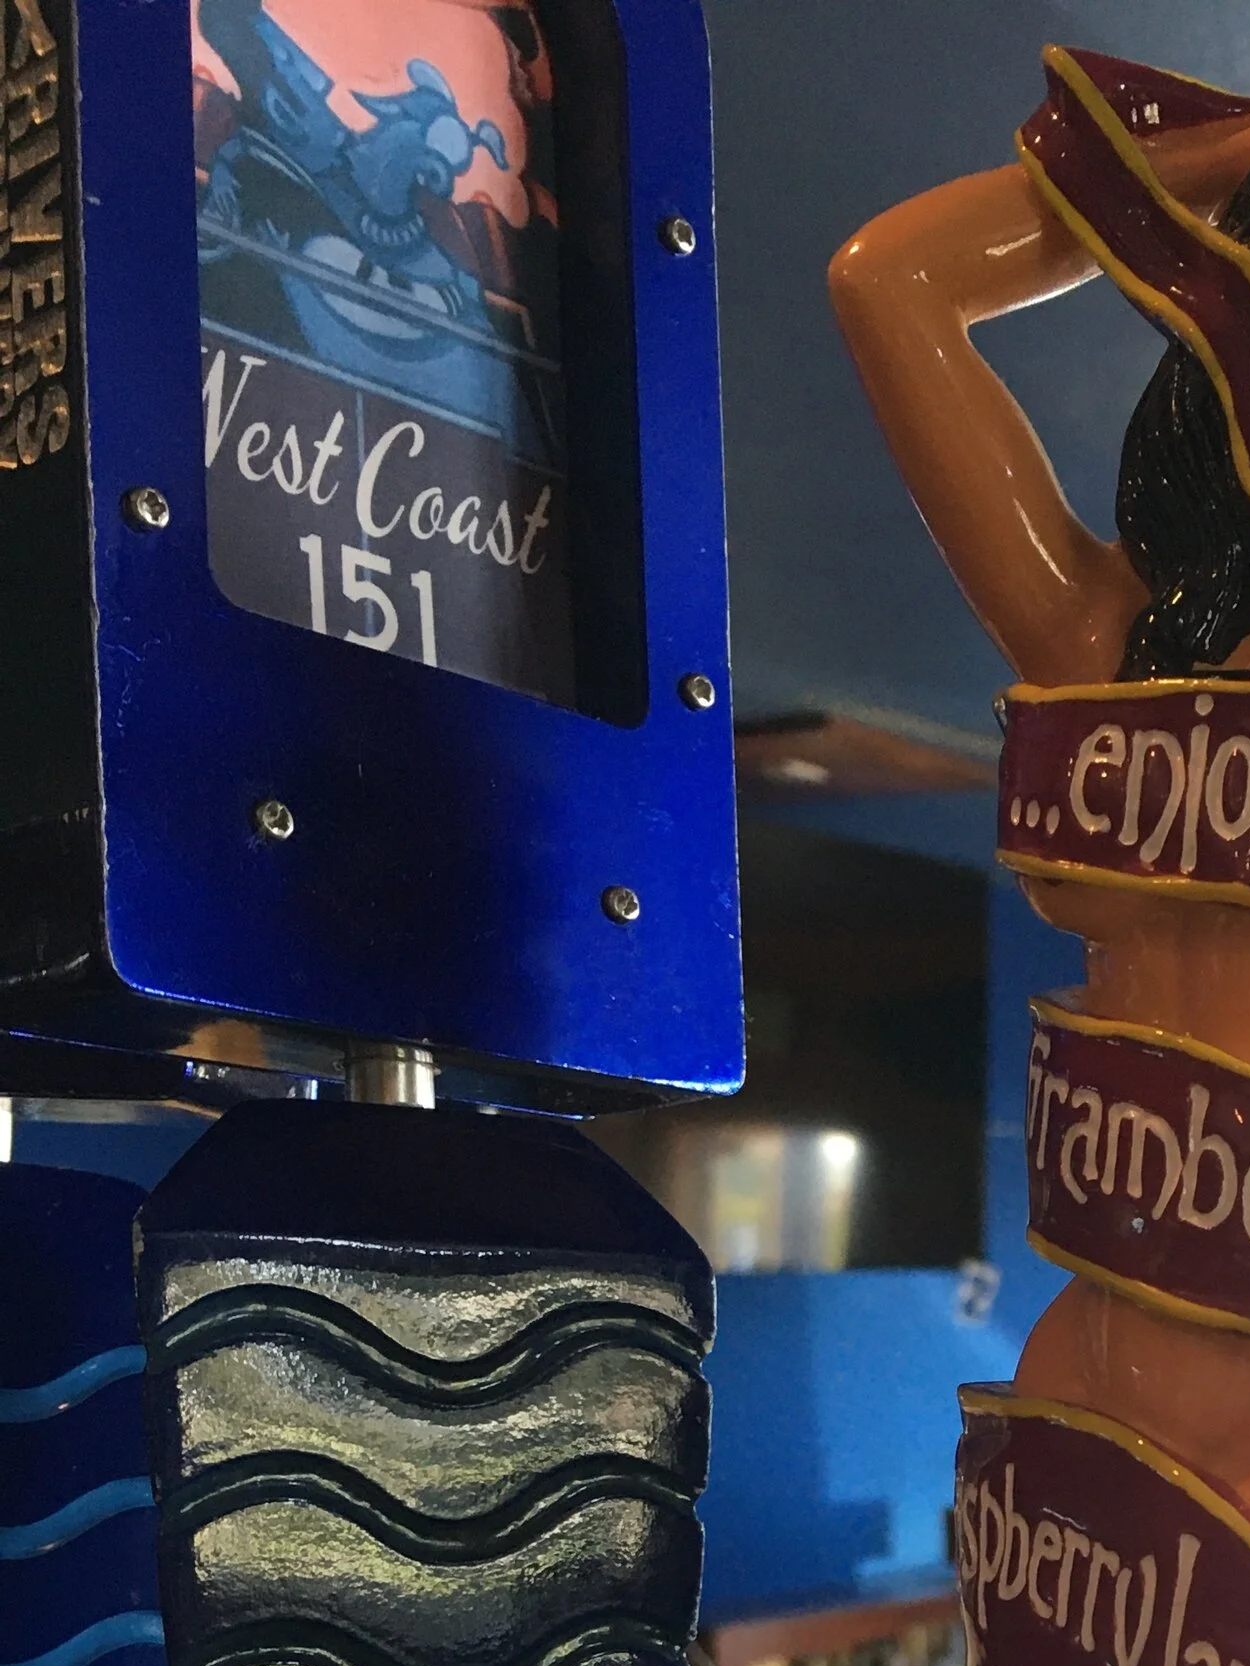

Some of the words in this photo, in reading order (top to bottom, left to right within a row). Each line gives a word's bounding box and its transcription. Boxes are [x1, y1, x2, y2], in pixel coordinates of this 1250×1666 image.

[7, 54, 71, 466] RIVERS
[355, 421, 551, 574] Coast
[299, 533, 438, 668] 151
